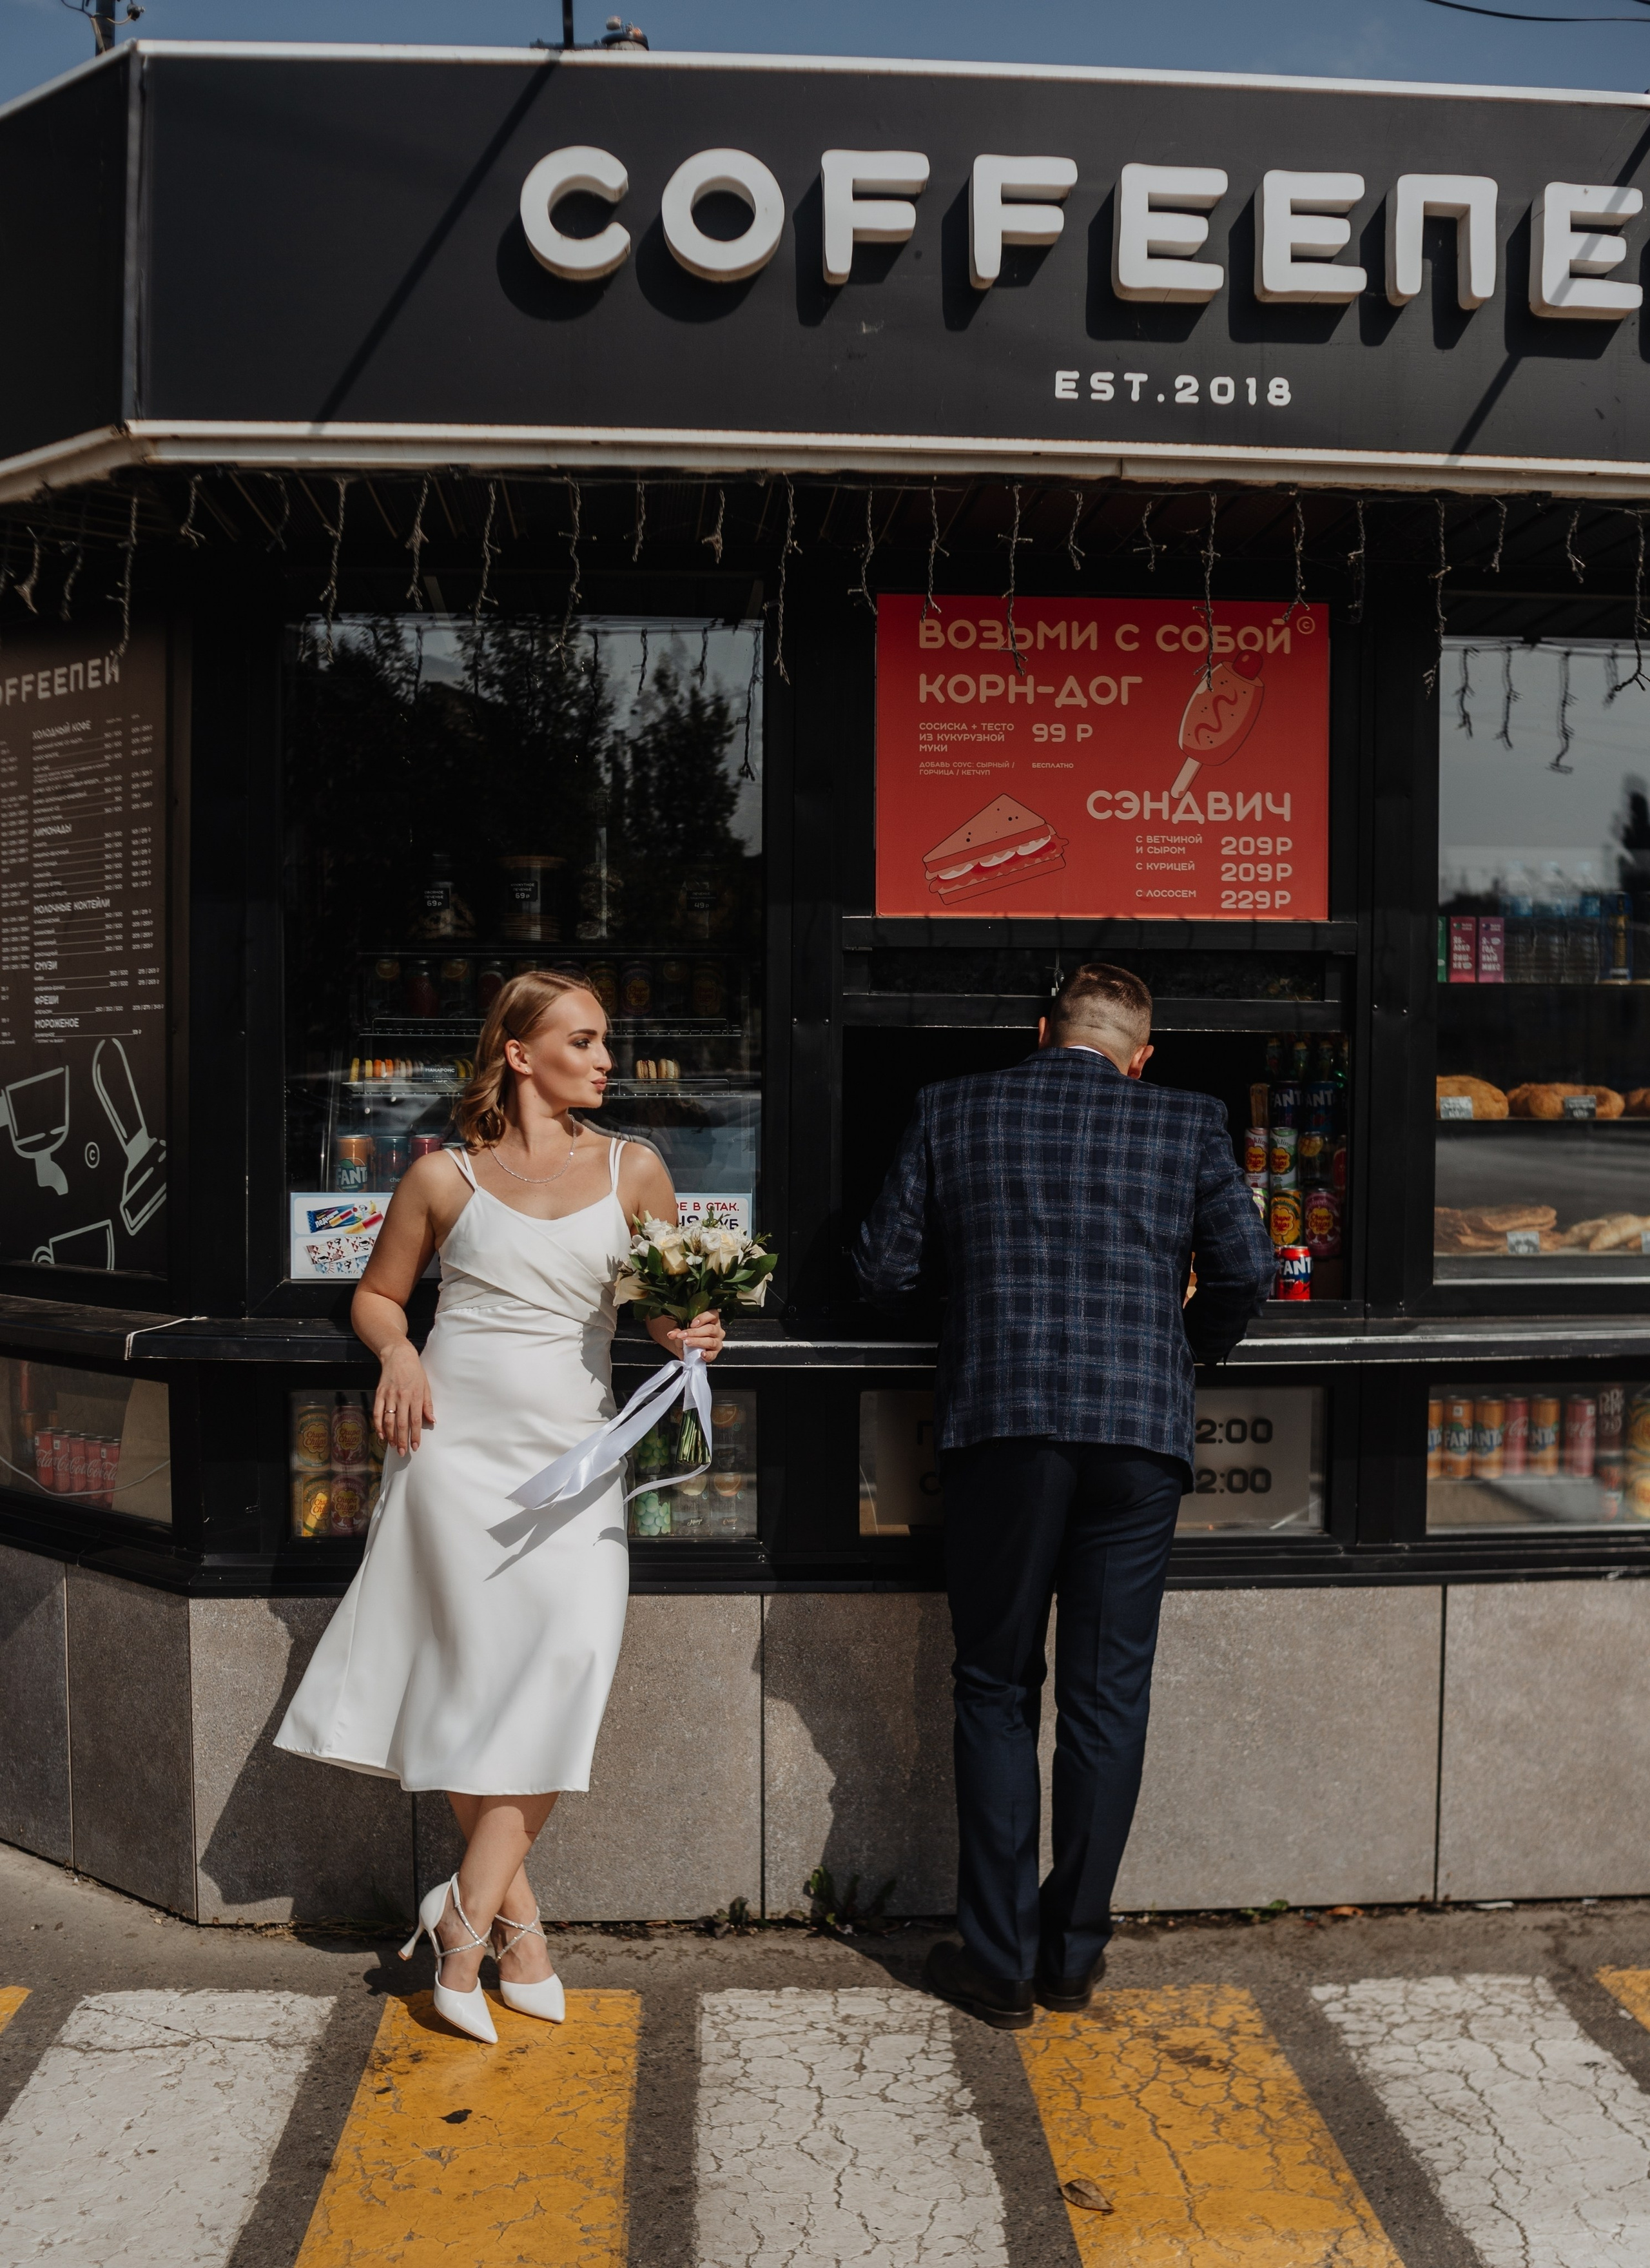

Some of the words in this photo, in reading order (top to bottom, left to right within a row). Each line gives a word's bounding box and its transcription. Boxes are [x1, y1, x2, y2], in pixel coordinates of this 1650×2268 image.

[1054, 370, 1292, 406] EST.2018
[919, 619, 1098, 650] ВОЗЬМИ
[1115, 624, 1140, 651] С
[1156, 618, 1291, 654] СОБОЙ
[919, 674, 1143, 708] КОРН-ДОГ
[937, 732, 1005, 741] КУКУРУЗНОЙ
[1032, 723, 1066, 742] 99
[1087, 790, 1291, 825] СЭНДВИЧ
[1146, 834, 1203, 844] ВЕТЧИНОЙ
[1147, 846, 1185, 854] СЫРОМ
[1146, 861, 1195, 871] КУРИЦЕЙ
[35, 1018, 79, 1029] МОРОЖЕНОЕ
[336, 1166, 367, 1186] FANT
[693, 1202, 701, 1211] В
